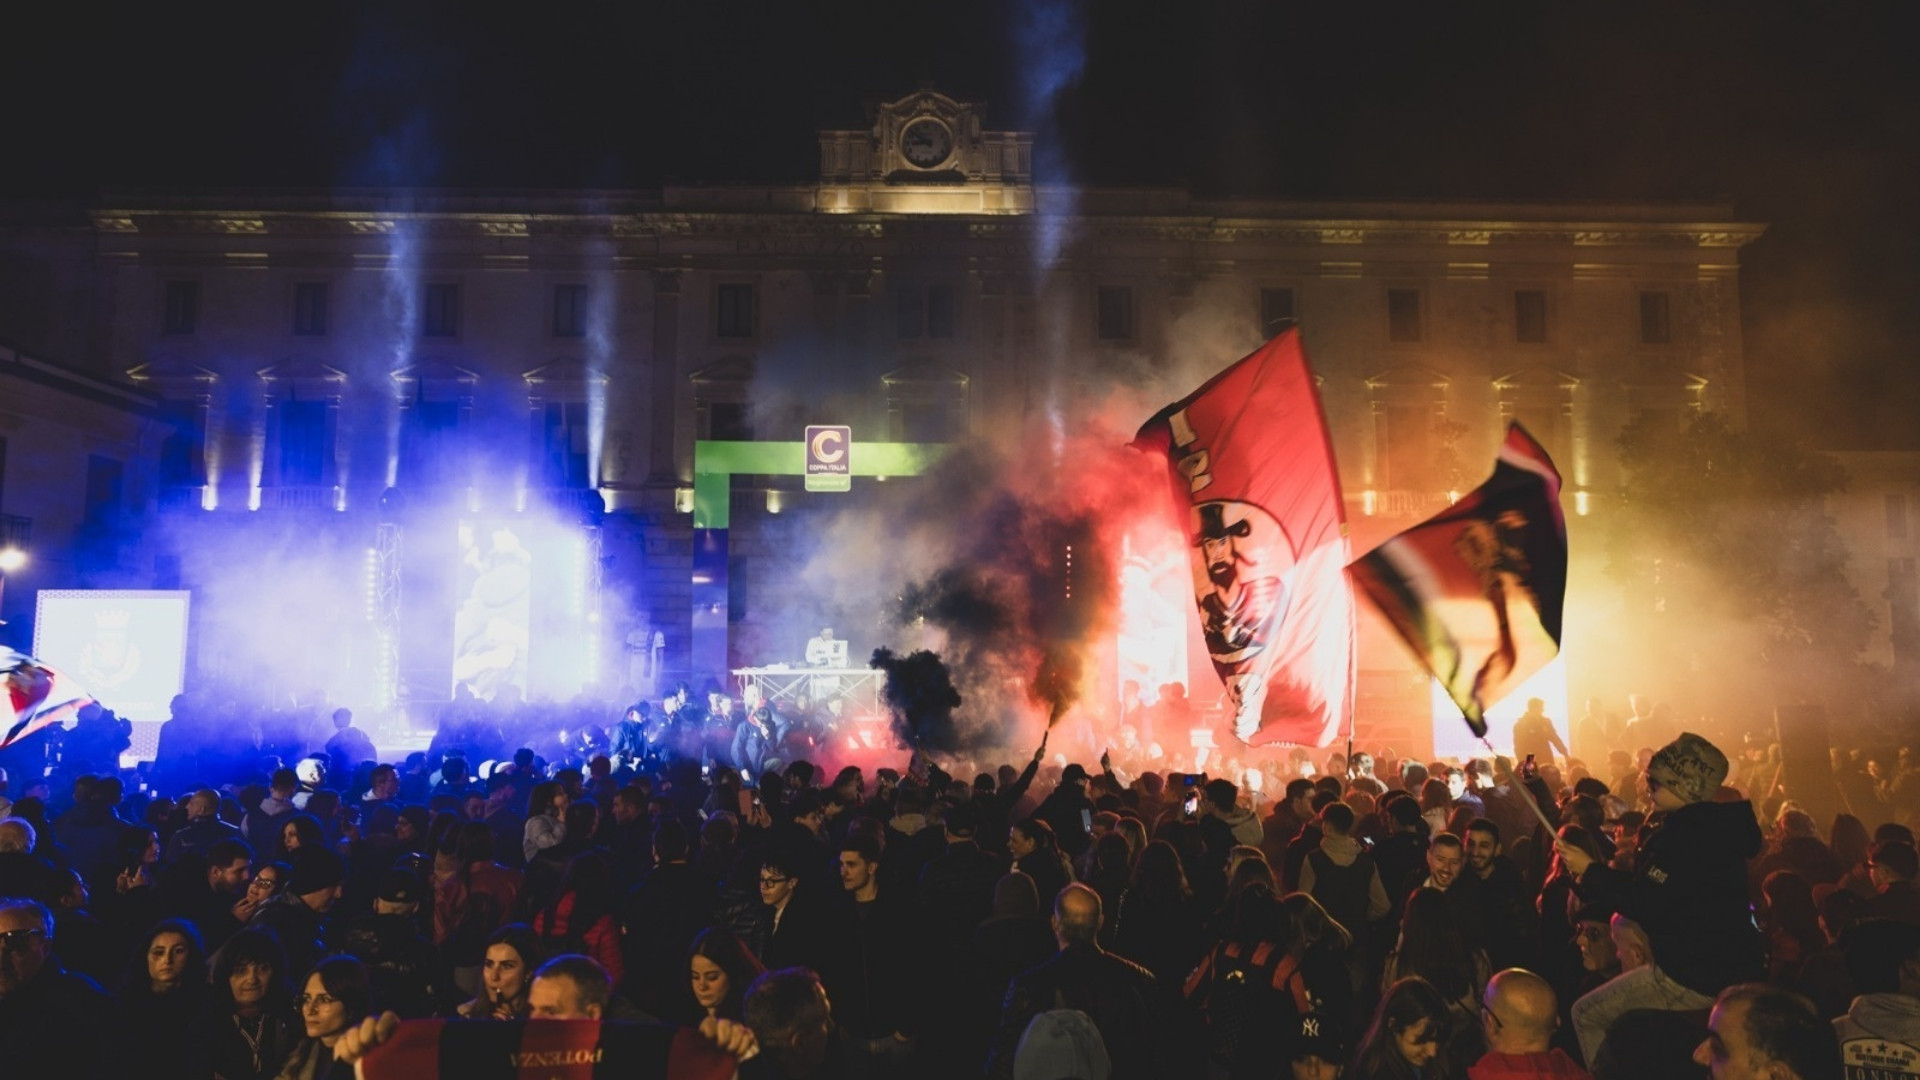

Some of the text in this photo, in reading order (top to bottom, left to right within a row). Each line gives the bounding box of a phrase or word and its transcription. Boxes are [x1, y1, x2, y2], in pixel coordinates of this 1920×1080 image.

[736, 240, 866, 255] PALAZZO
[1302, 1018, 1319, 1037] NY
[509, 1048, 604, 1067] POTENZA
[1844, 1066, 1920, 1080] LONDO
